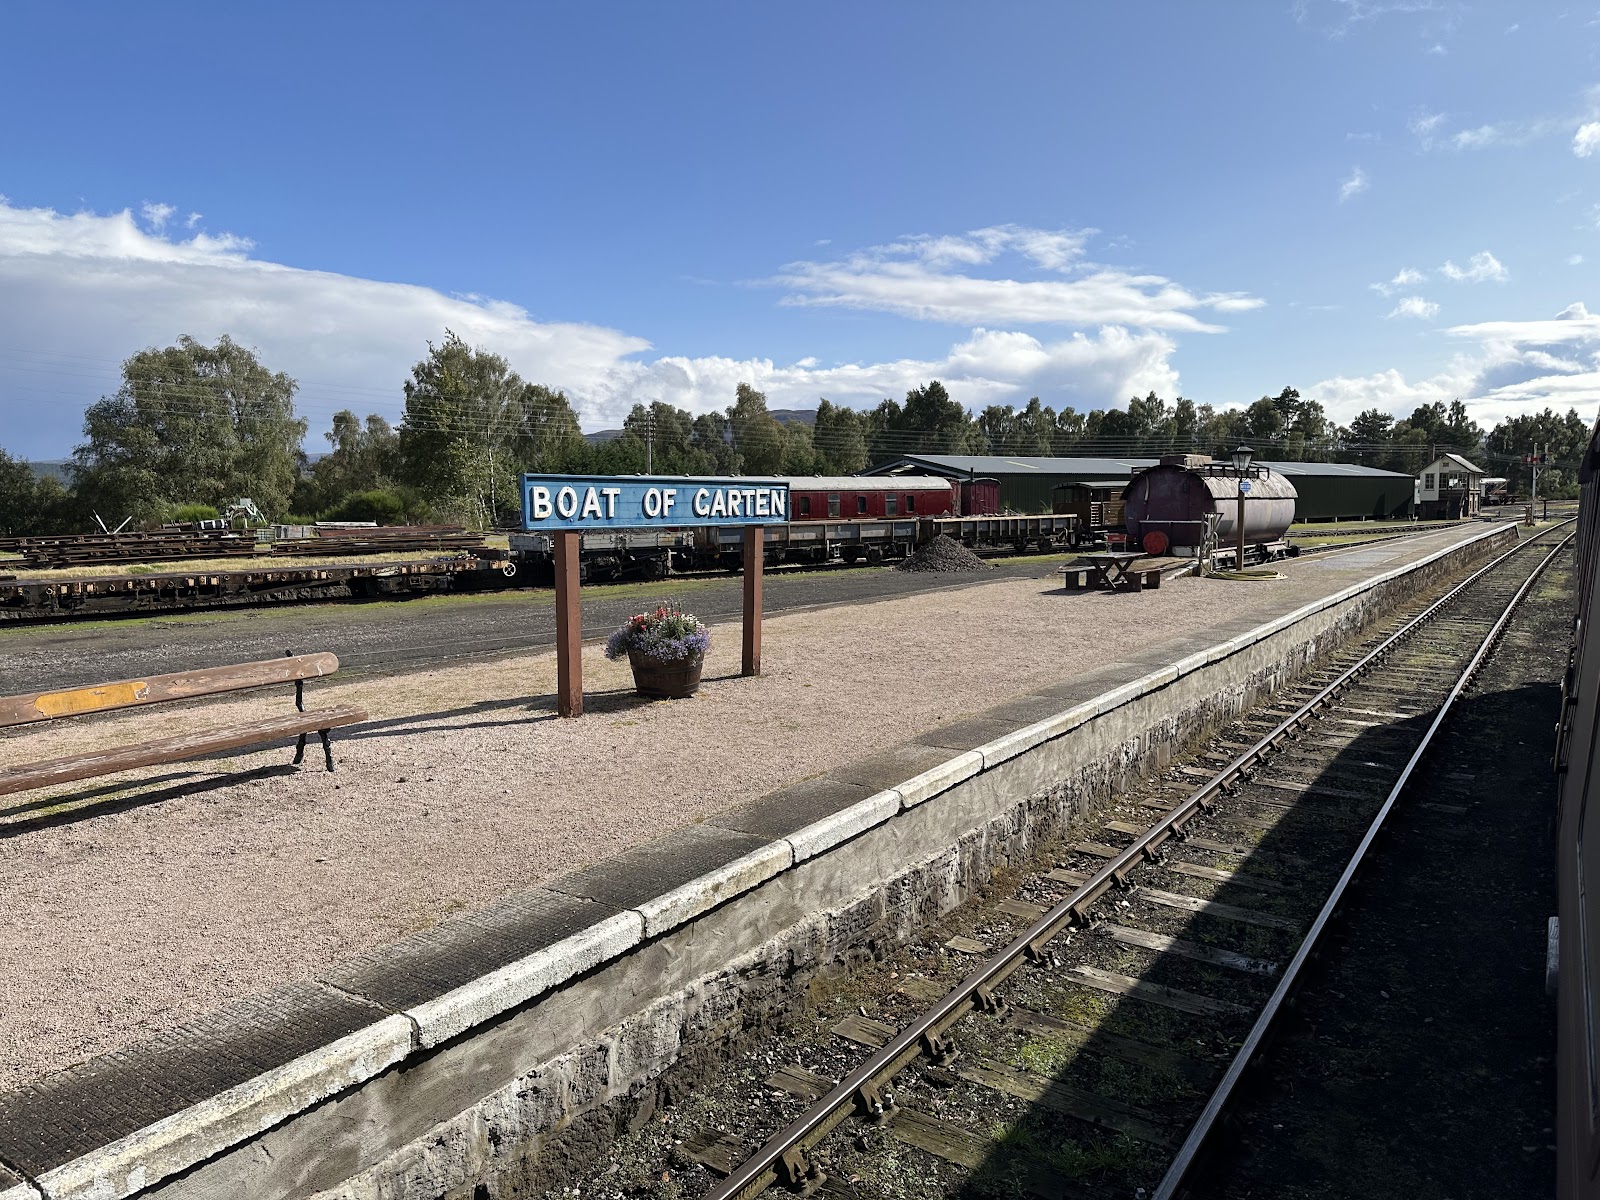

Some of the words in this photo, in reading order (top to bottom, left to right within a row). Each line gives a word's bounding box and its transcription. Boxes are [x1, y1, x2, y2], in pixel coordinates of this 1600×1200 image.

[532, 486, 621, 519] BOAT
[643, 487, 677, 517] OF
[694, 487, 786, 517] GARTEN
